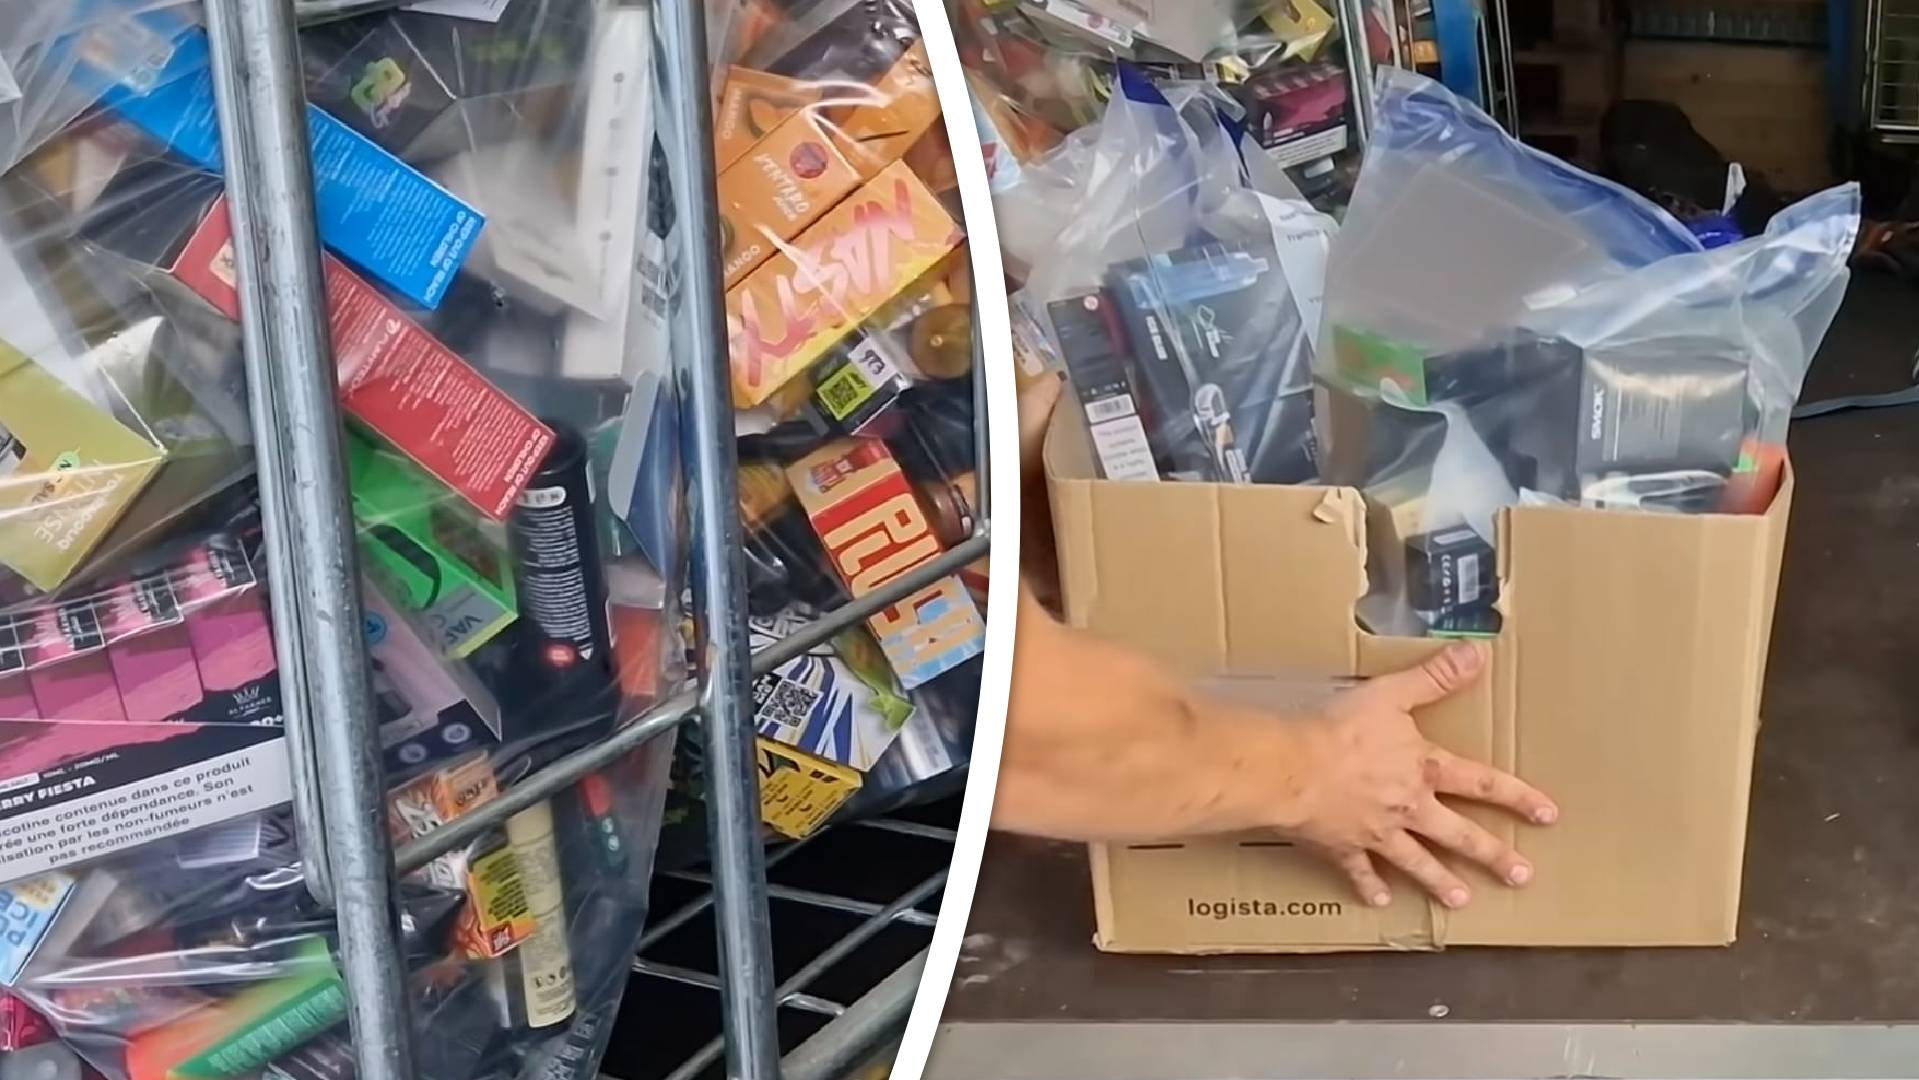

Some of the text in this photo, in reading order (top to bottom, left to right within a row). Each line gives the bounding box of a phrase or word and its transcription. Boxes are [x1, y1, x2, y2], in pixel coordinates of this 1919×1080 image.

[424, 216, 477, 303] KEEP OUT OF REACH
[429, 210, 466, 268] OF CHILDREN
[1591, 384, 1604, 440] SMOK
[495, 434, 549, 515] KEEP OUT OF REACH
[504, 428, 541, 482] OF CHILDREN
[27, 829, 56, 843] une
[60, 819, 96, 834] forte
[203, 777, 234, 793] Son
[38, 776, 96, 799] FIESTA
[55, 796, 127, 821] contenue
[131, 785, 168, 800] dans
[174, 776, 191, 787] ce
[196, 757, 252, 785] produit
[58, 835, 82, 849] par
[88, 827, 110, 838] les
[115, 797, 212, 832] non-fumeurs
[218, 784, 254, 801] n'est
[49, 817, 189, 865] pas recommandée
[1188, 898, 1342, 919] logista.com
